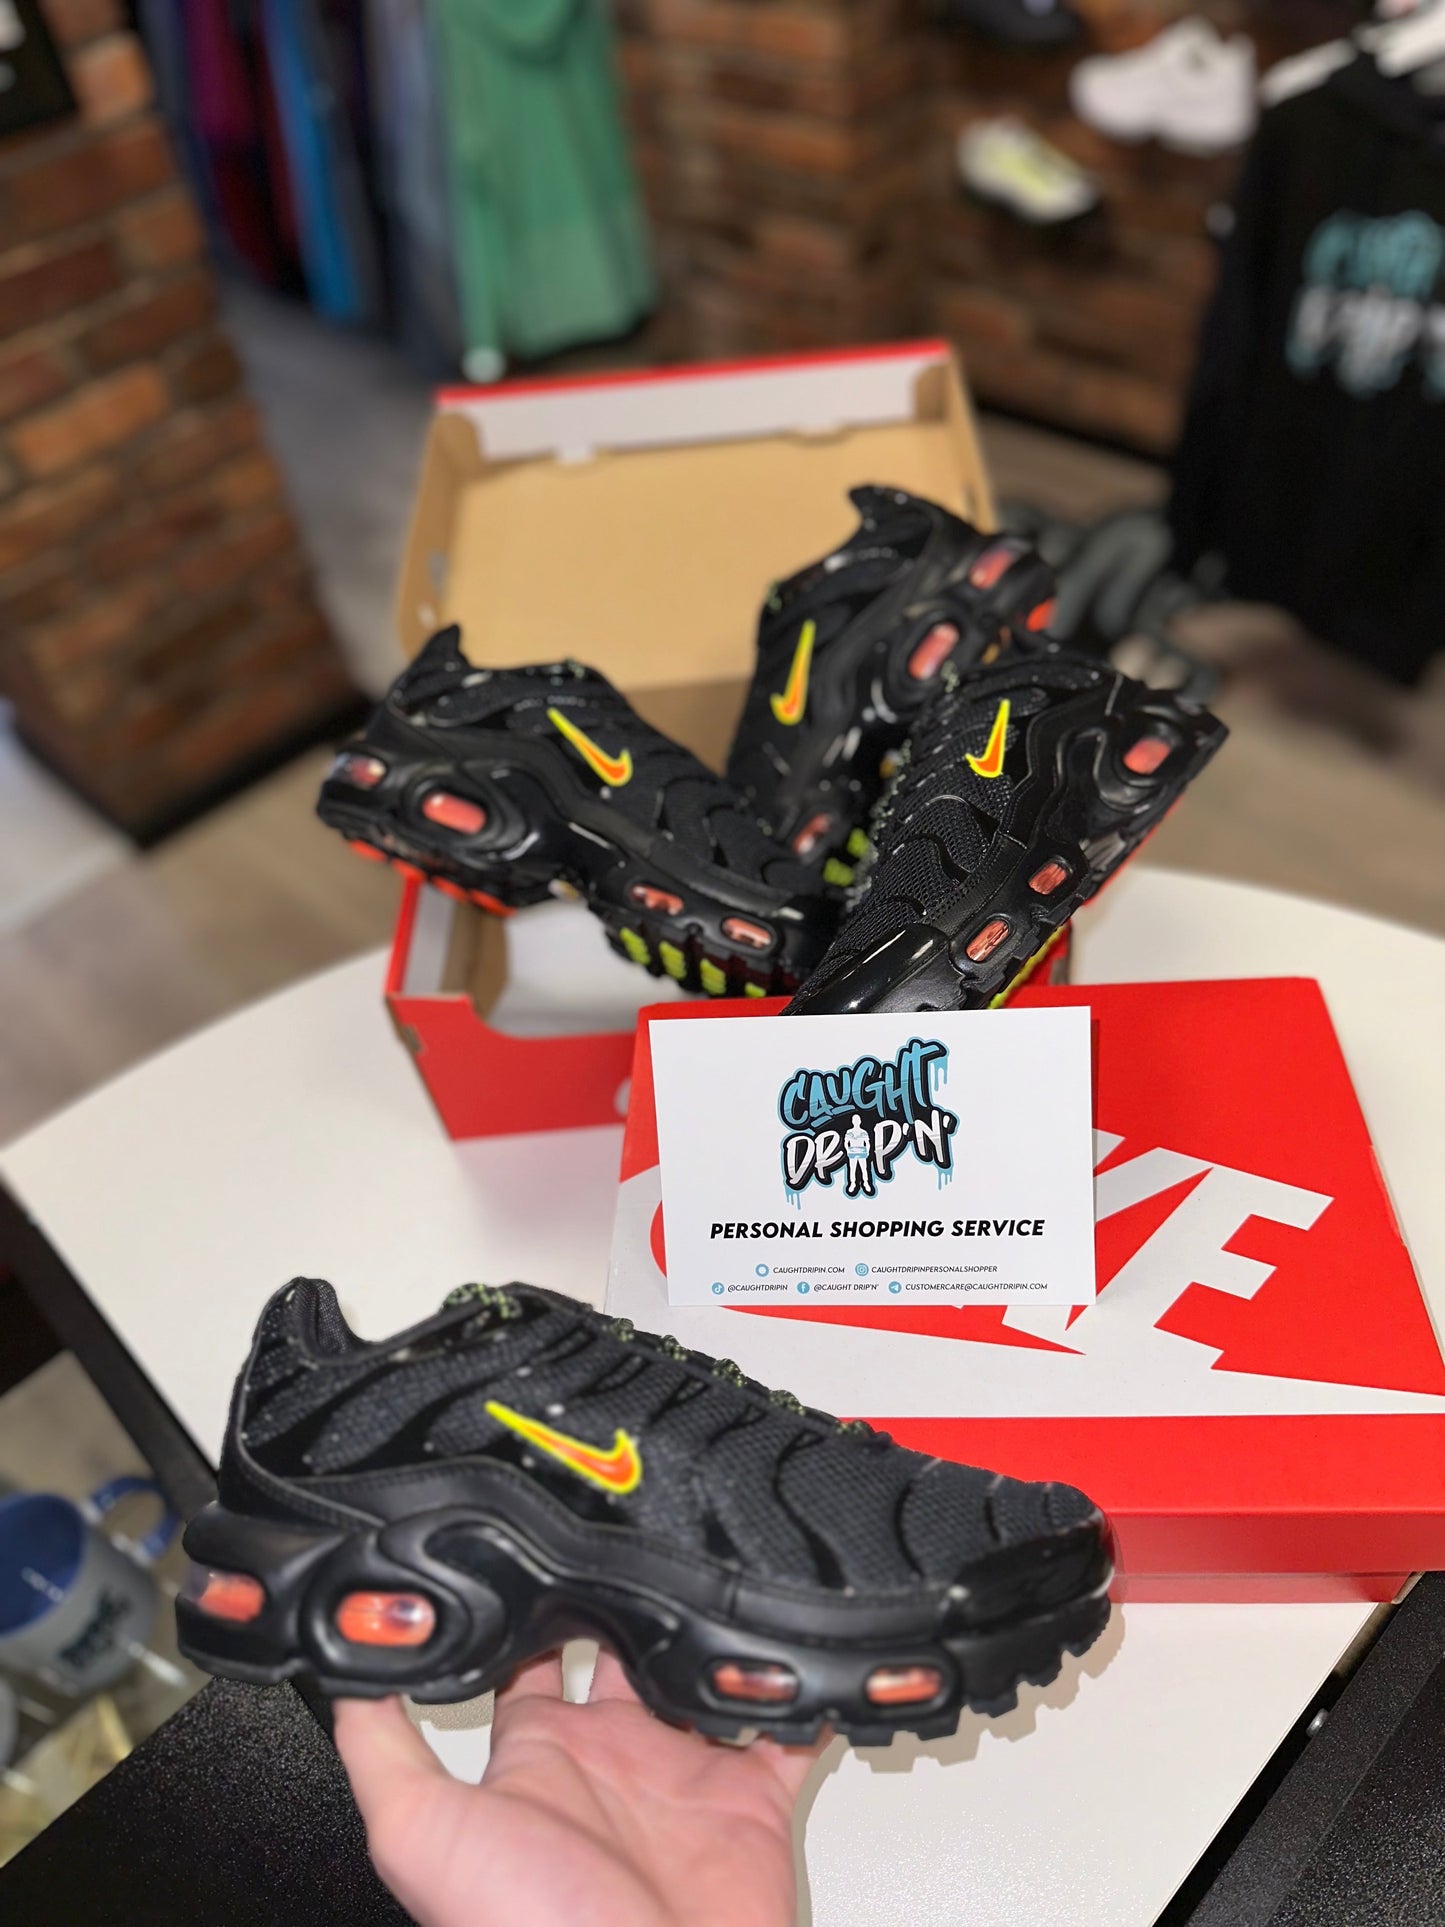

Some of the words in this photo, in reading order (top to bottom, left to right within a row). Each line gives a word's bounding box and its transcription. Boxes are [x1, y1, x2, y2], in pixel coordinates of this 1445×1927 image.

[781, 1040, 944, 1128] CAUGHT
[710, 1221, 824, 1240] PERSONAL
[829, 1219, 945, 1238] SHOPPING
[950, 1219, 1046, 1237] SERVICE
[772, 1266, 846, 1274] CAUGHTDRIPIN.COM
[871, 1265, 998, 1274] CAUGHTDRIPINPERSONALSHOPPER
[727, 1284, 789, 1293] @CAUGHTDRIPIN
[813, 1283, 852, 1293] @CAUGHT
[905, 1282, 1048, 1292] CUSTOMERCARE@CAUGHTDRIPIN.COM
